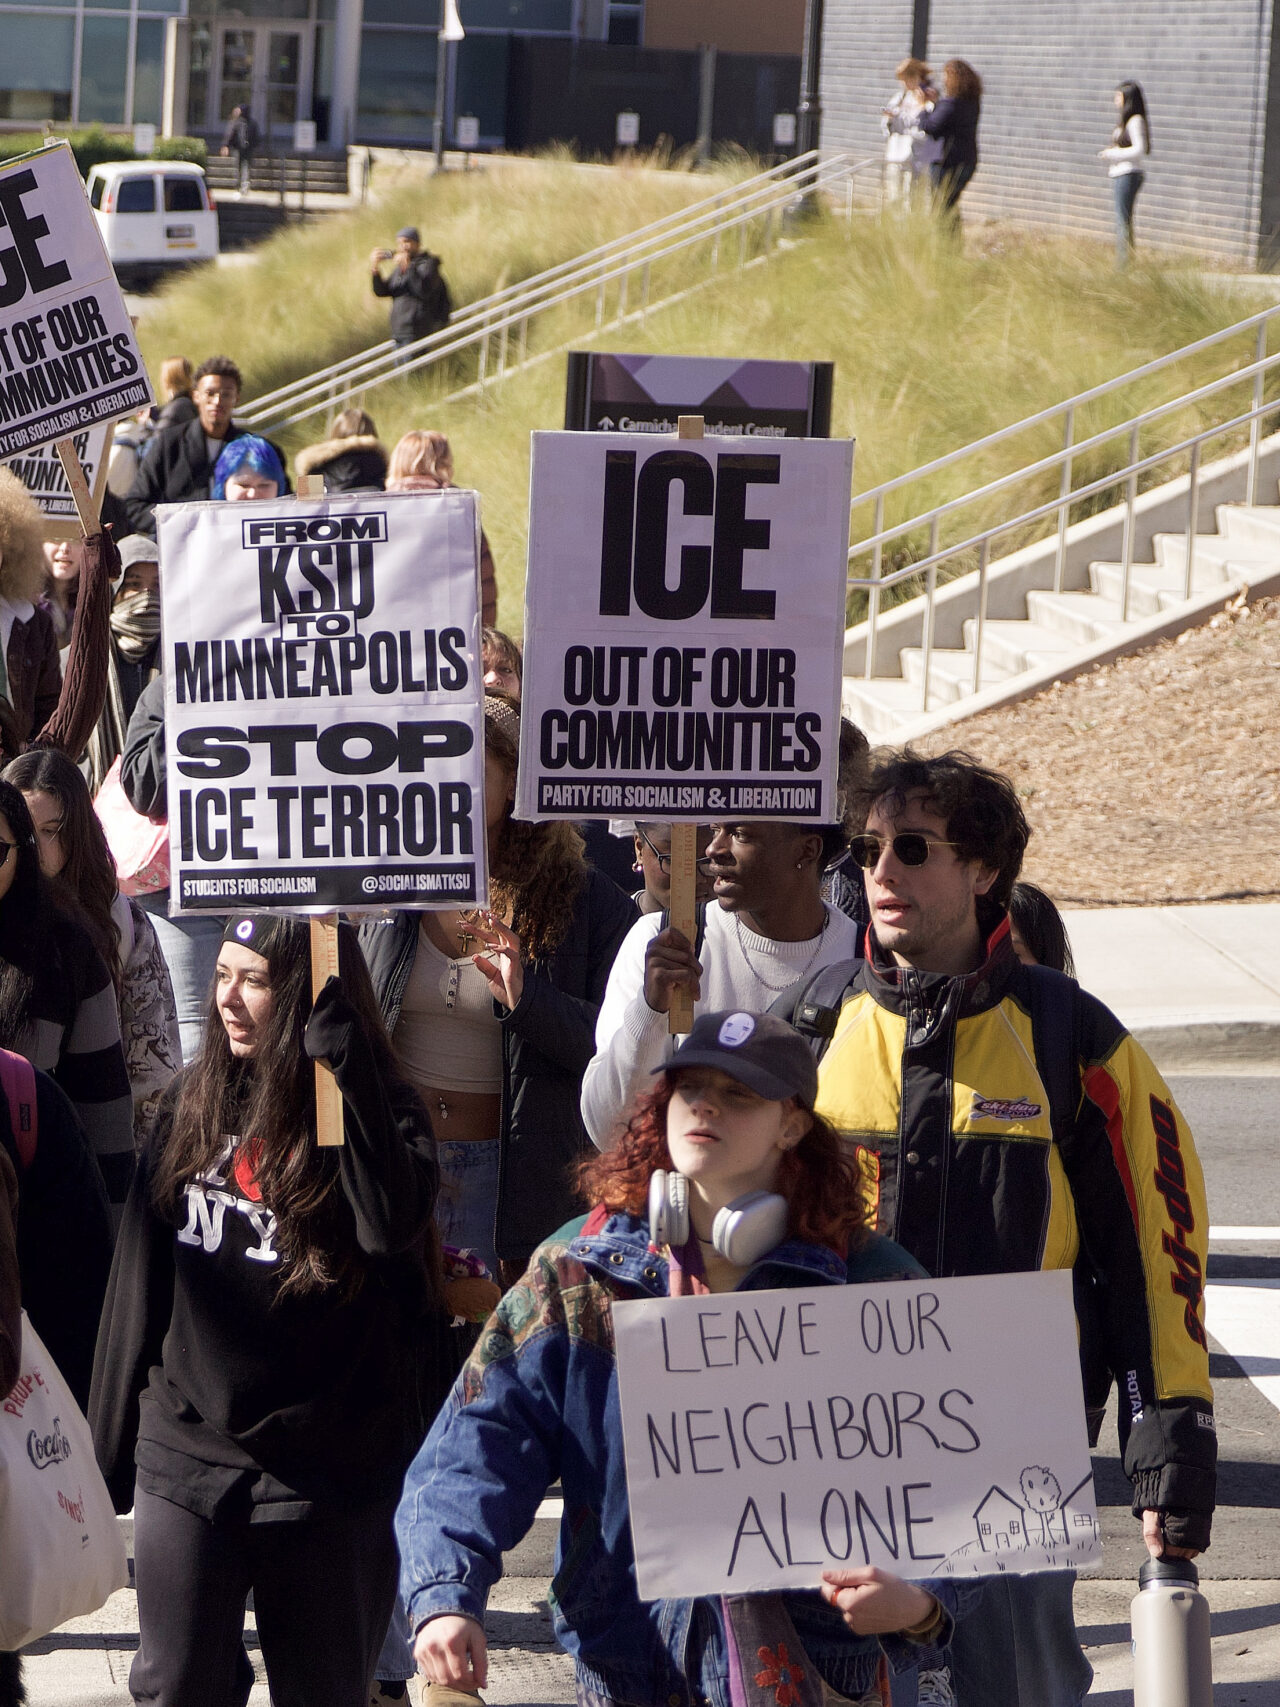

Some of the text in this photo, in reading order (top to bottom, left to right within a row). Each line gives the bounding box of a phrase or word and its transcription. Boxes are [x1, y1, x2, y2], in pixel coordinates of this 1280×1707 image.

[12, 314, 47, 364] OF
[47, 296, 108, 351] OUR
[10, 429, 30, 449] FOR
[29, 411, 79, 440] SOCIALISM
[79, 406, 93, 421] &
[91, 384, 147, 416] LIBERATION
[619, 416, 788, 437] Carmicha udent Center
[49, 499, 77, 513] LIBERAT
[250, 517, 381, 544] FROM
[599, 449, 781, 621] ICE
[258, 543, 374, 624] KSU
[287, 614, 351, 637] TO
[174, 626, 469, 704] MINNEAPOLIS
[563, 645, 797, 709] OUT OF OUR
[176, 720, 474, 779] STOP
[540, 709, 822, 772] COMMUNITIES
[179, 781, 474, 862] ICE TERROR
[542, 784, 816, 809] PARTY FOR SOCIALISM & LIBERATION
[183, 873, 471, 897] STUDENTS FOR SOCIALISM @SOCIALISMATKSU
[177, 1183, 278, 1261] NY
[661, 1292, 951, 1372] LEAVE OUR
[1127, 1369, 1144, 1423] ROTAX
[1197, 1413, 1217, 1431] RP
[647, 1388, 980, 1479] NEIGHBORS
[727, 1482, 946, 1577] ALONE
